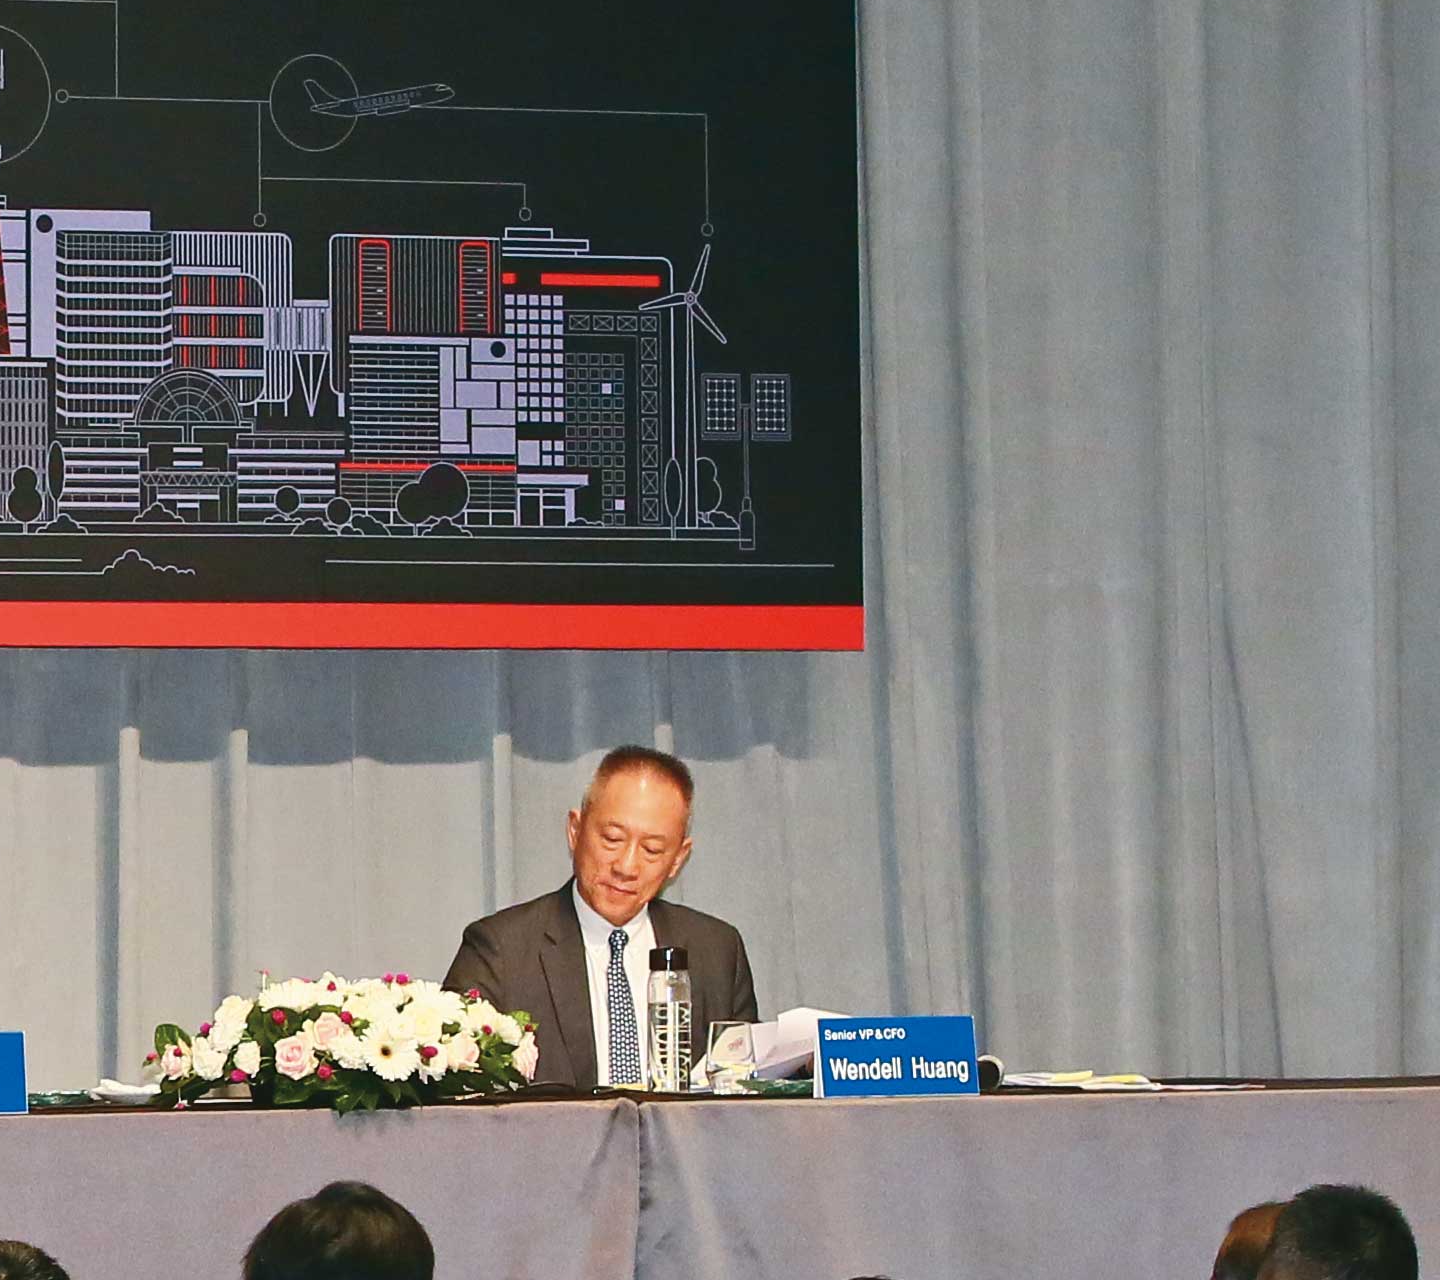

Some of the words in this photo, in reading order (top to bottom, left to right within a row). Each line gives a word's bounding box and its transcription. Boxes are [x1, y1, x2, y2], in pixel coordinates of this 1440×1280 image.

[824, 1029, 857, 1041] Senior
[829, 1057, 902, 1081] Wendell
[911, 1056, 969, 1083] Huang
